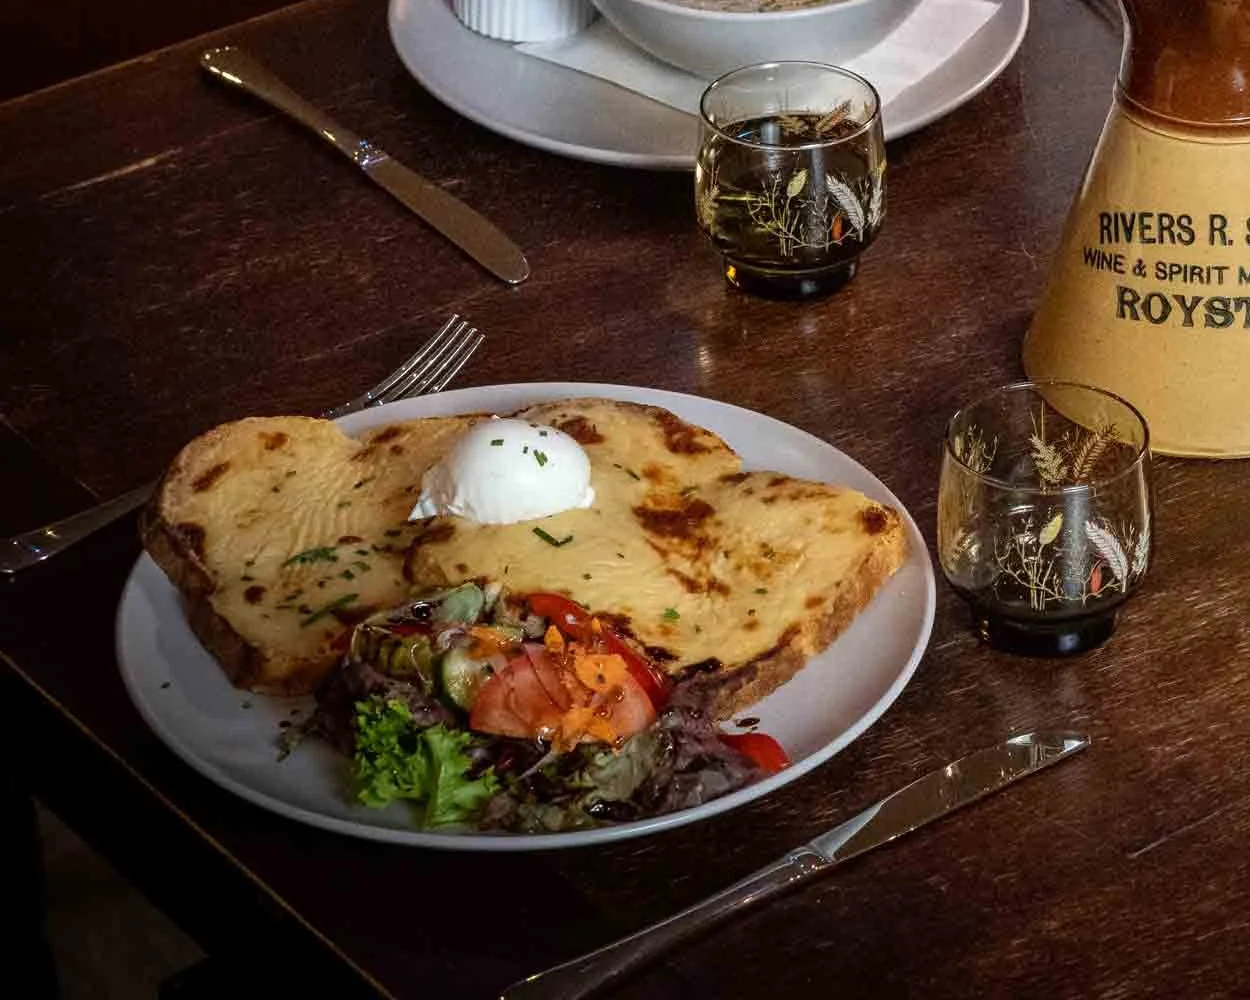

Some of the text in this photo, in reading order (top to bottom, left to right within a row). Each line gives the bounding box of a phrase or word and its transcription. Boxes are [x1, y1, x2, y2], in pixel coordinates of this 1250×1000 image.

[1098, 211, 1196, 247] RIVERS
[1208, 213, 1234, 247] R.
[1083, 246, 1126, 275] WINE
[1132, 259, 1147, 278] &
[1154, 261, 1230, 285] SPIRIT
